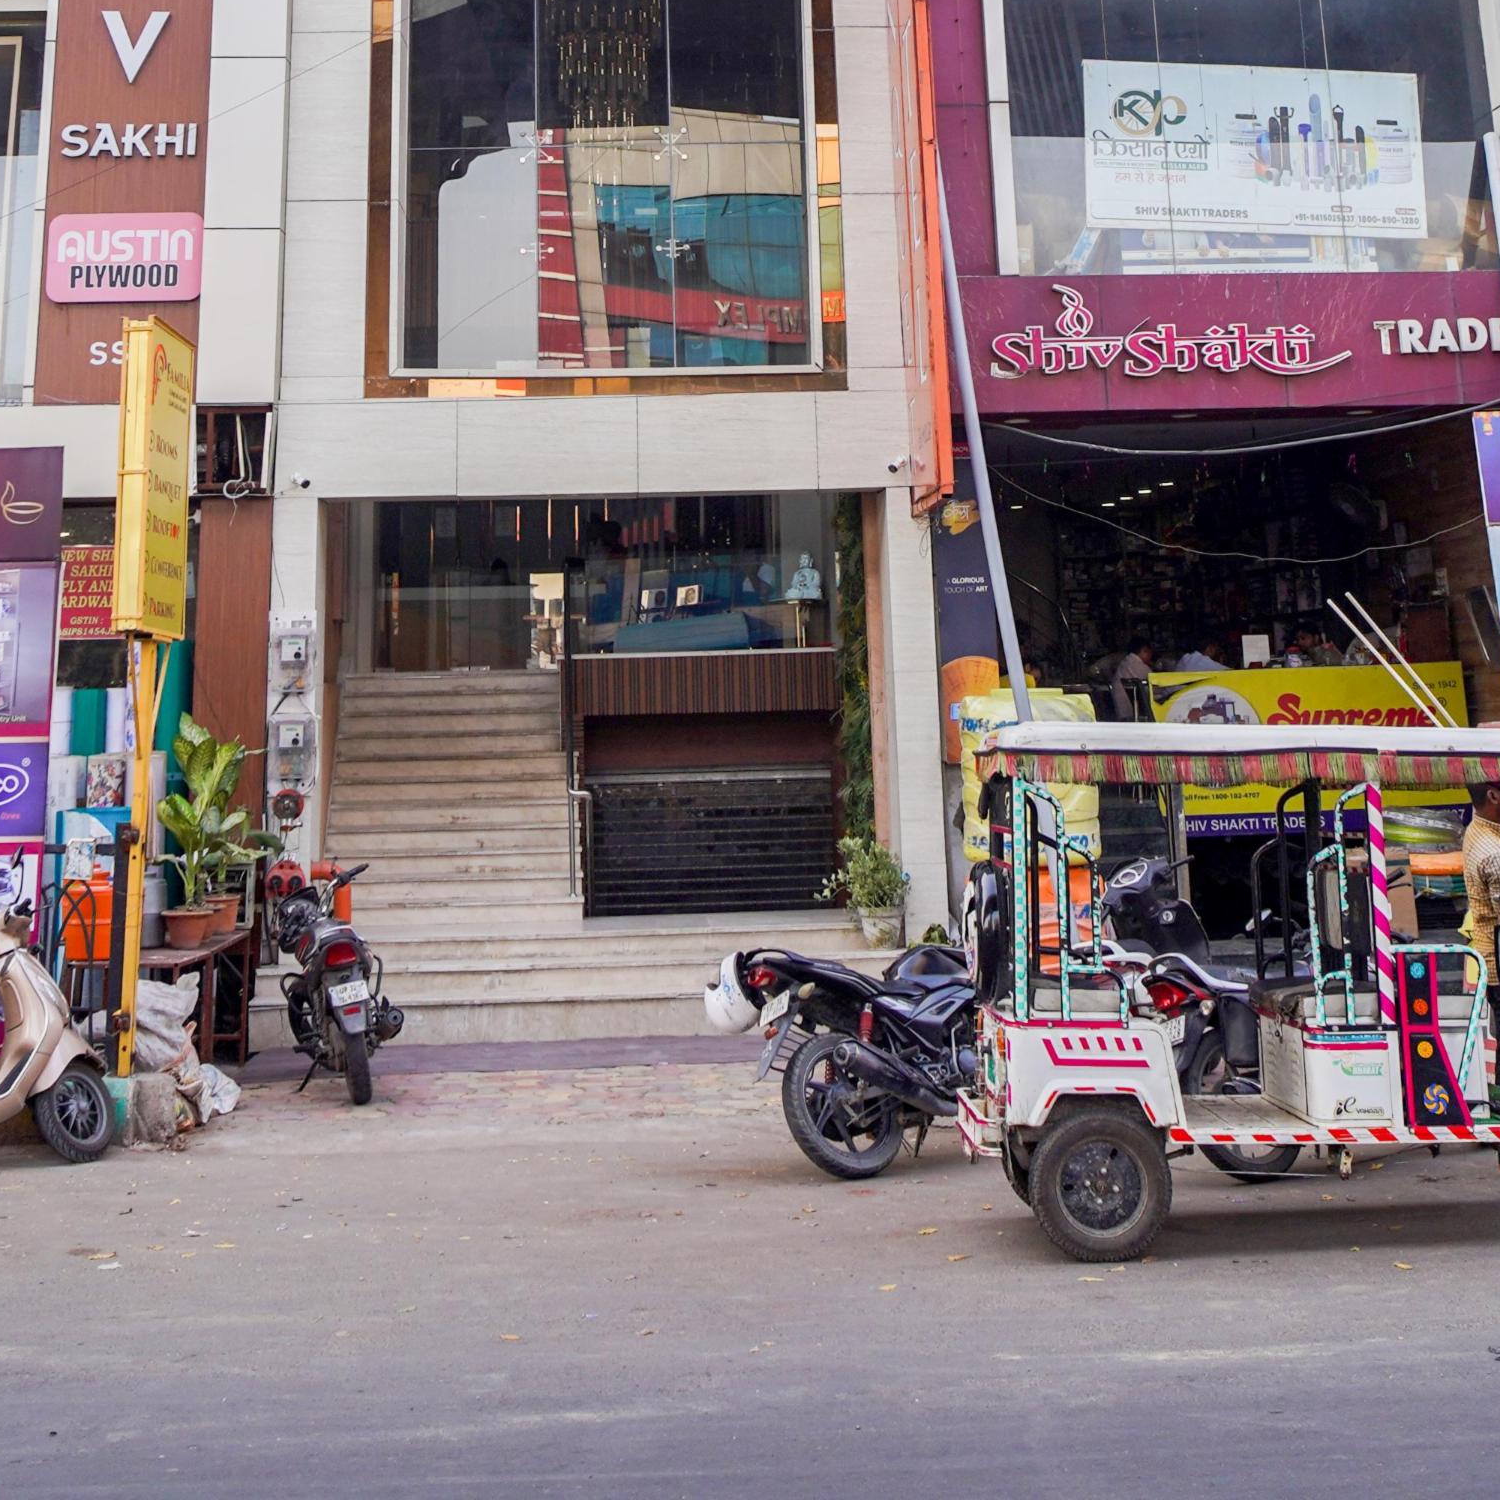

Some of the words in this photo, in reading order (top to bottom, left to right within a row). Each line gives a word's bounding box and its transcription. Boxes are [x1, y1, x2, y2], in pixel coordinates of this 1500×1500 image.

[61, 122, 198, 159] SAKHI
[1090, 129, 1171, 158] किसान
[1134, 206, 1160, 216] SHIV
[1161, 207, 1200, 217] SHAKTI
[1202, 208, 1249, 219] TRADERS
[58, 229, 193, 263] AUSTIN
[70, 264, 179, 289] PLYWOOD
[951, 576, 985, 584] GLORIOUS
[70, 615, 98, 625] GSTIN
[1185, 819, 1208, 832] HIV
[1210, 817, 1260, 831] SHAKTI
